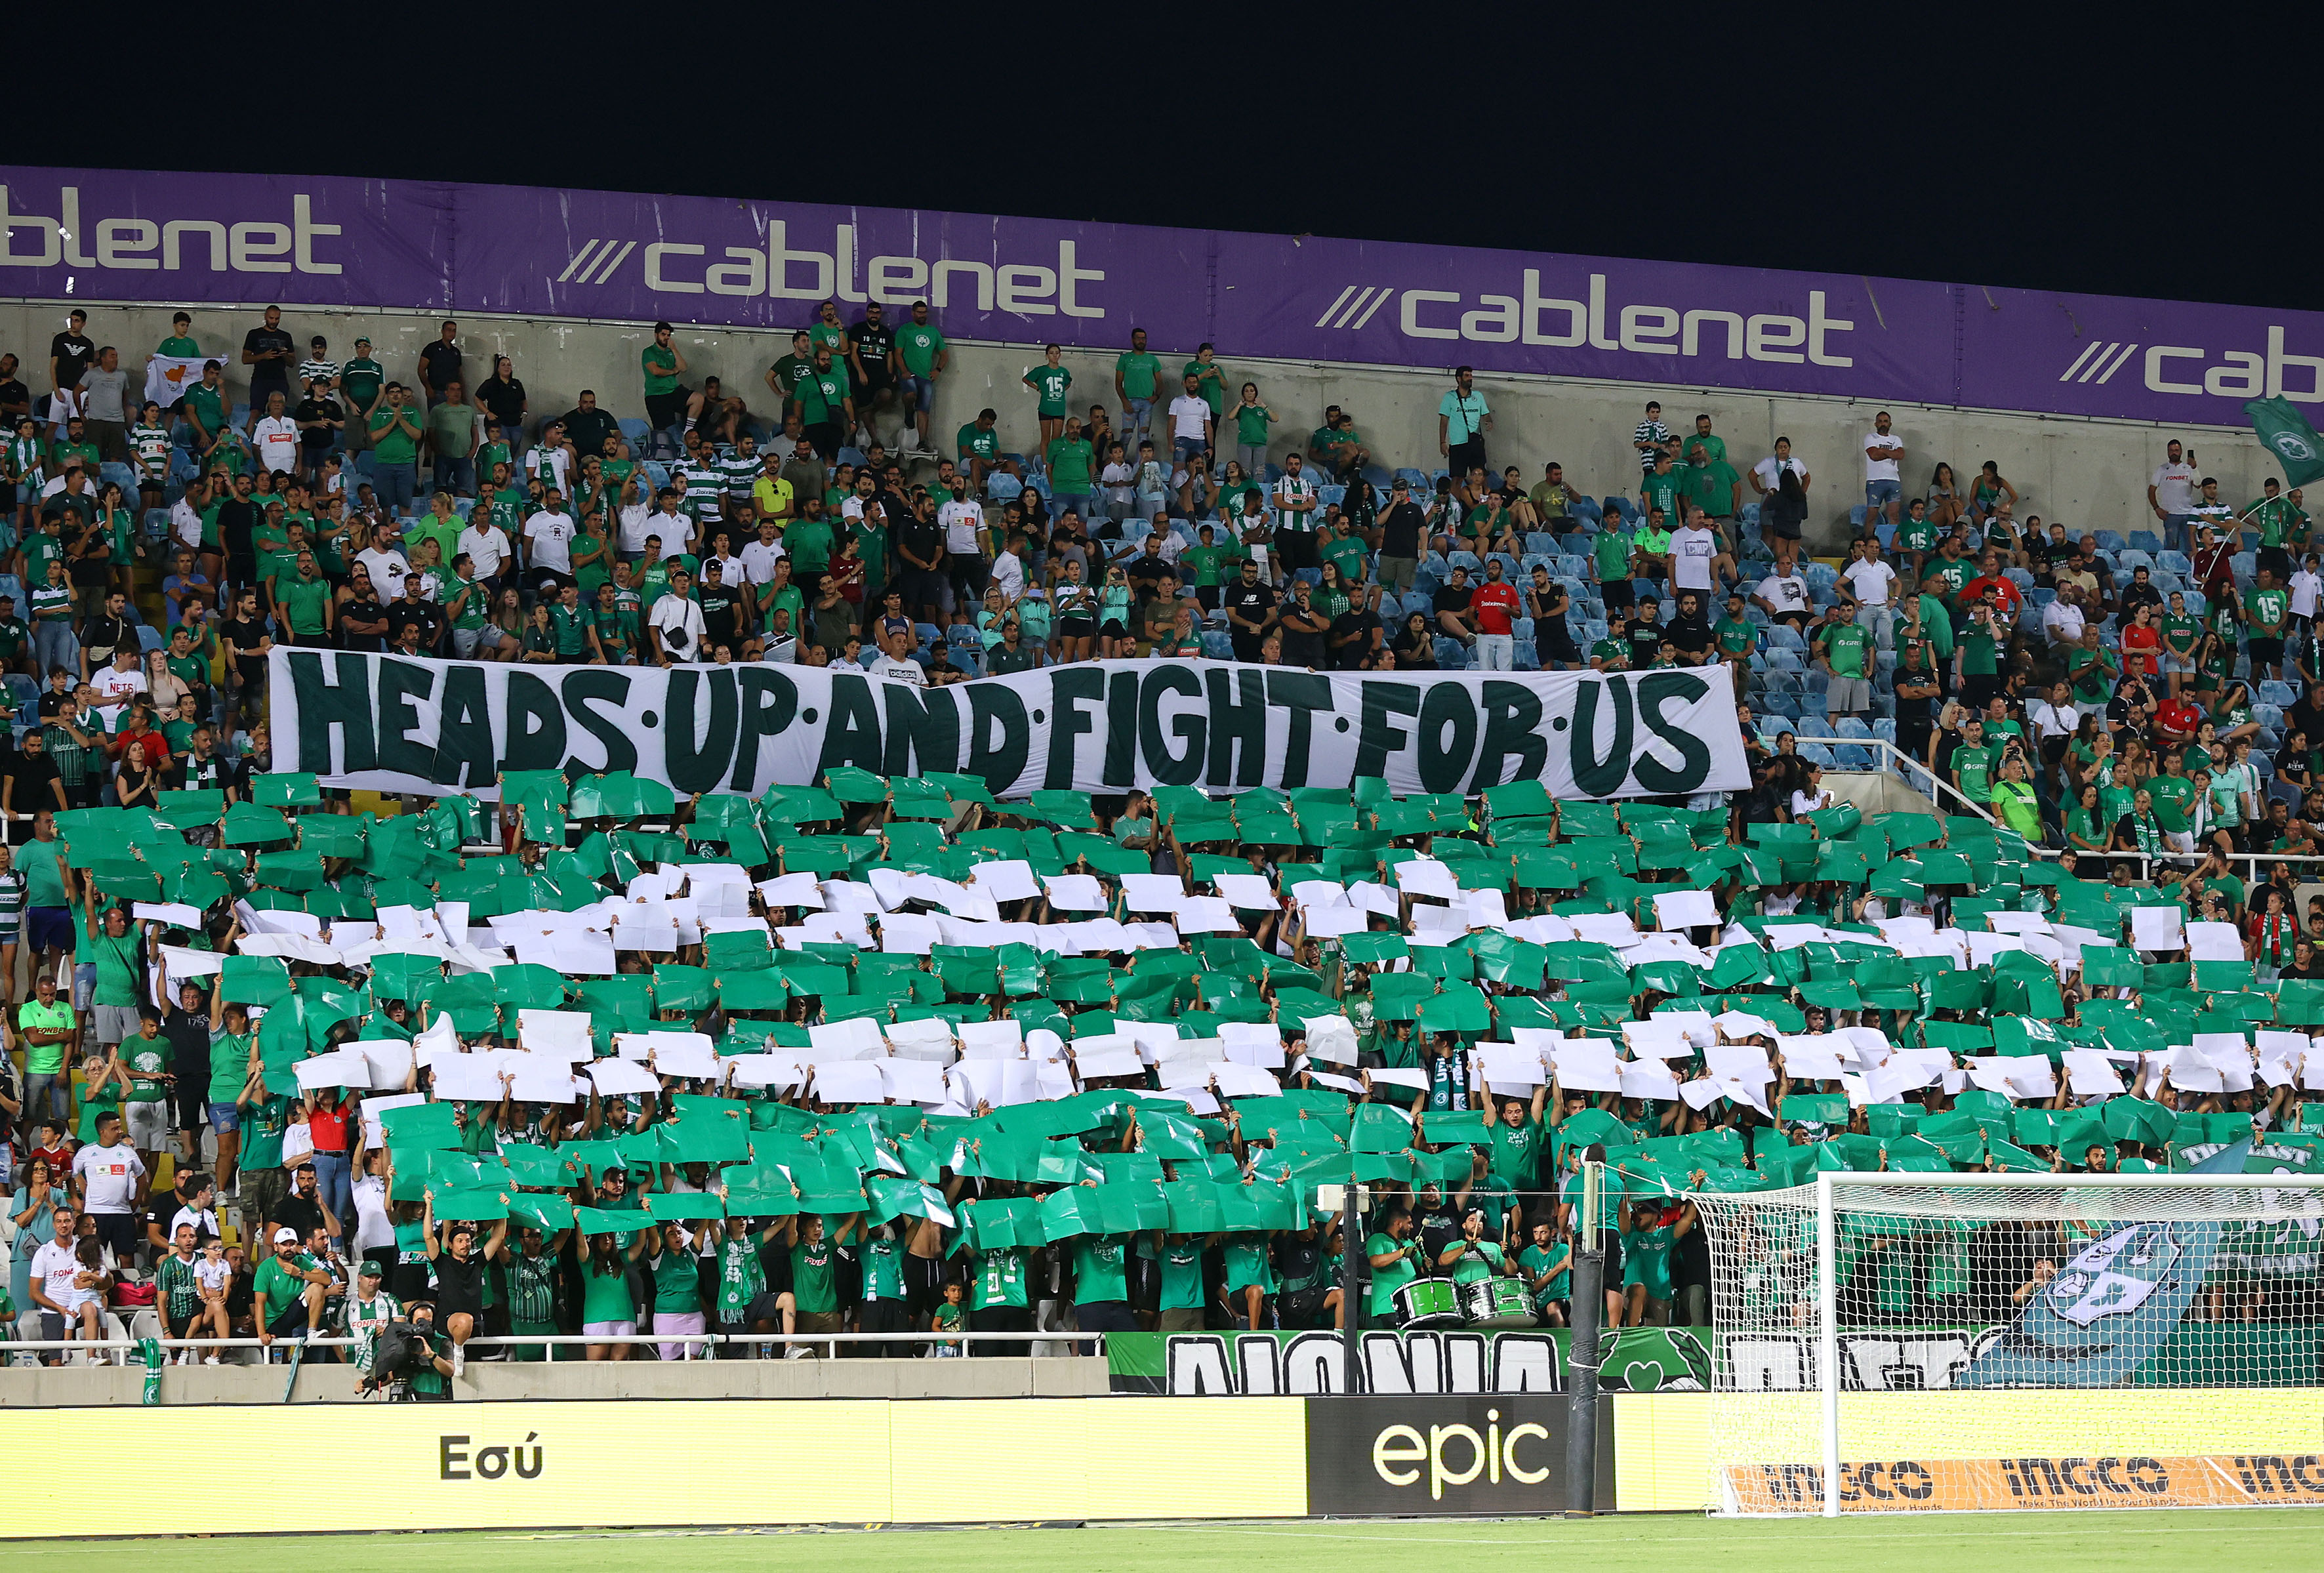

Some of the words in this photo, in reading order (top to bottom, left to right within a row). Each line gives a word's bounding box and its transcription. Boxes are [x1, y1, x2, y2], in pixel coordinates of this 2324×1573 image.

[644, 219, 1105, 317] cablenet
[1400, 268, 1854, 367] cablenet
[2144, 325, 2324, 403] cab
[1046, 377, 1063, 398] 15
[1909, 532, 1927, 550] 15
[1942, 569, 1963, 589] 15
[2257, 596, 2281, 623] 15
[288, 651, 638, 788] HEADS
[664, 666, 799, 795] UP
[812, 674, 1030, 796] AND
[1044, 664, 1335, 790] FIGHT
[1350, 680, 1547, 796] FOR
[1570, 672, 1711, 798] US
[352, 1318, 386, 1328] FONBET
[440, 1431, 542, 1480] Εσύ
[1373, 1408, 1551, 1501] epic
[2018, 1500, 2047, 1508] Make
[2071, 1499, 2102, 1507] World
[2119, 1498, 2144, 1507] Your
[2145, 1498, 2180, 1506] Hands
